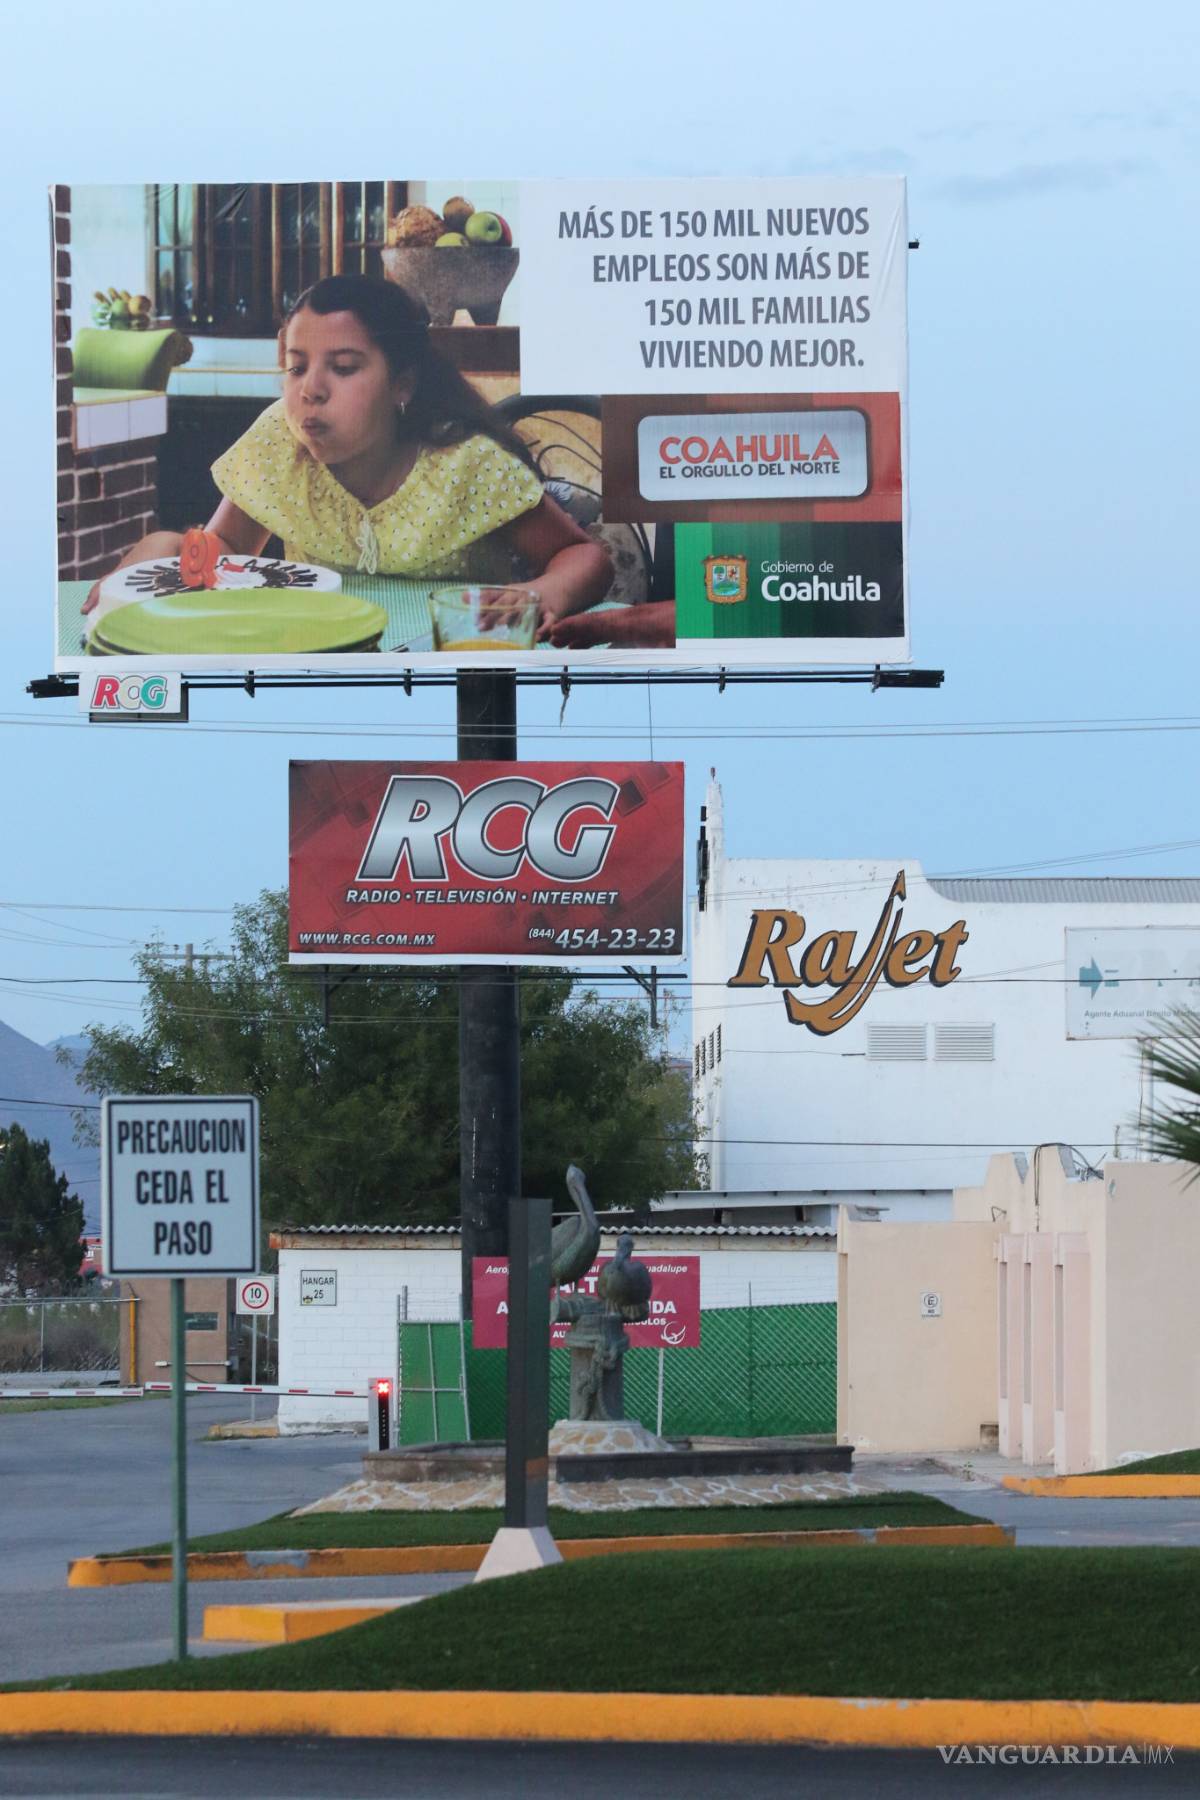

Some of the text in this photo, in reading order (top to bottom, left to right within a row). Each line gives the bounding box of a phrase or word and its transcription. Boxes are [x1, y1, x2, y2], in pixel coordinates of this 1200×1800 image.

[558, 205, 870, 238] MÁS DE 150 MIL NUEVOS
[593, 246, 870, 282] EMPLEOS SON MÁS DE
[645, 295, 871, 326] 150 MIL FAMILIAS
[640, 338, 864, 368] VIVIENDO MEJOR.
[659, 434, 840, 465] COAHUILA
[660, 461, 840, 479] EL ORGULLO DEL NORTE
[761, 560, 834, 574] Gobierno de
[761, 575, 881, 602] Coahuila
[90, 675, 168, 710] RCG
[355, 775, 621, 883] RCG
[346, 888, 618, 905] RADIO TELEVISIÓN INTERNET
[299, 933, 436, 945] WWW.RCG.COM.MX
[528, 928, 676, 949] (844) 454-23-23
[117, 1119, 246, 1154] PRECAUCION
[136, 1169, 229, 1204] CEDA EL
[154, 1221, 213, 1256] PASO
[250, 1288, 262, 1299] 10
[302, 1277, 335, 1286] HANGAR
[314, 1289, 325, 1299] 25
